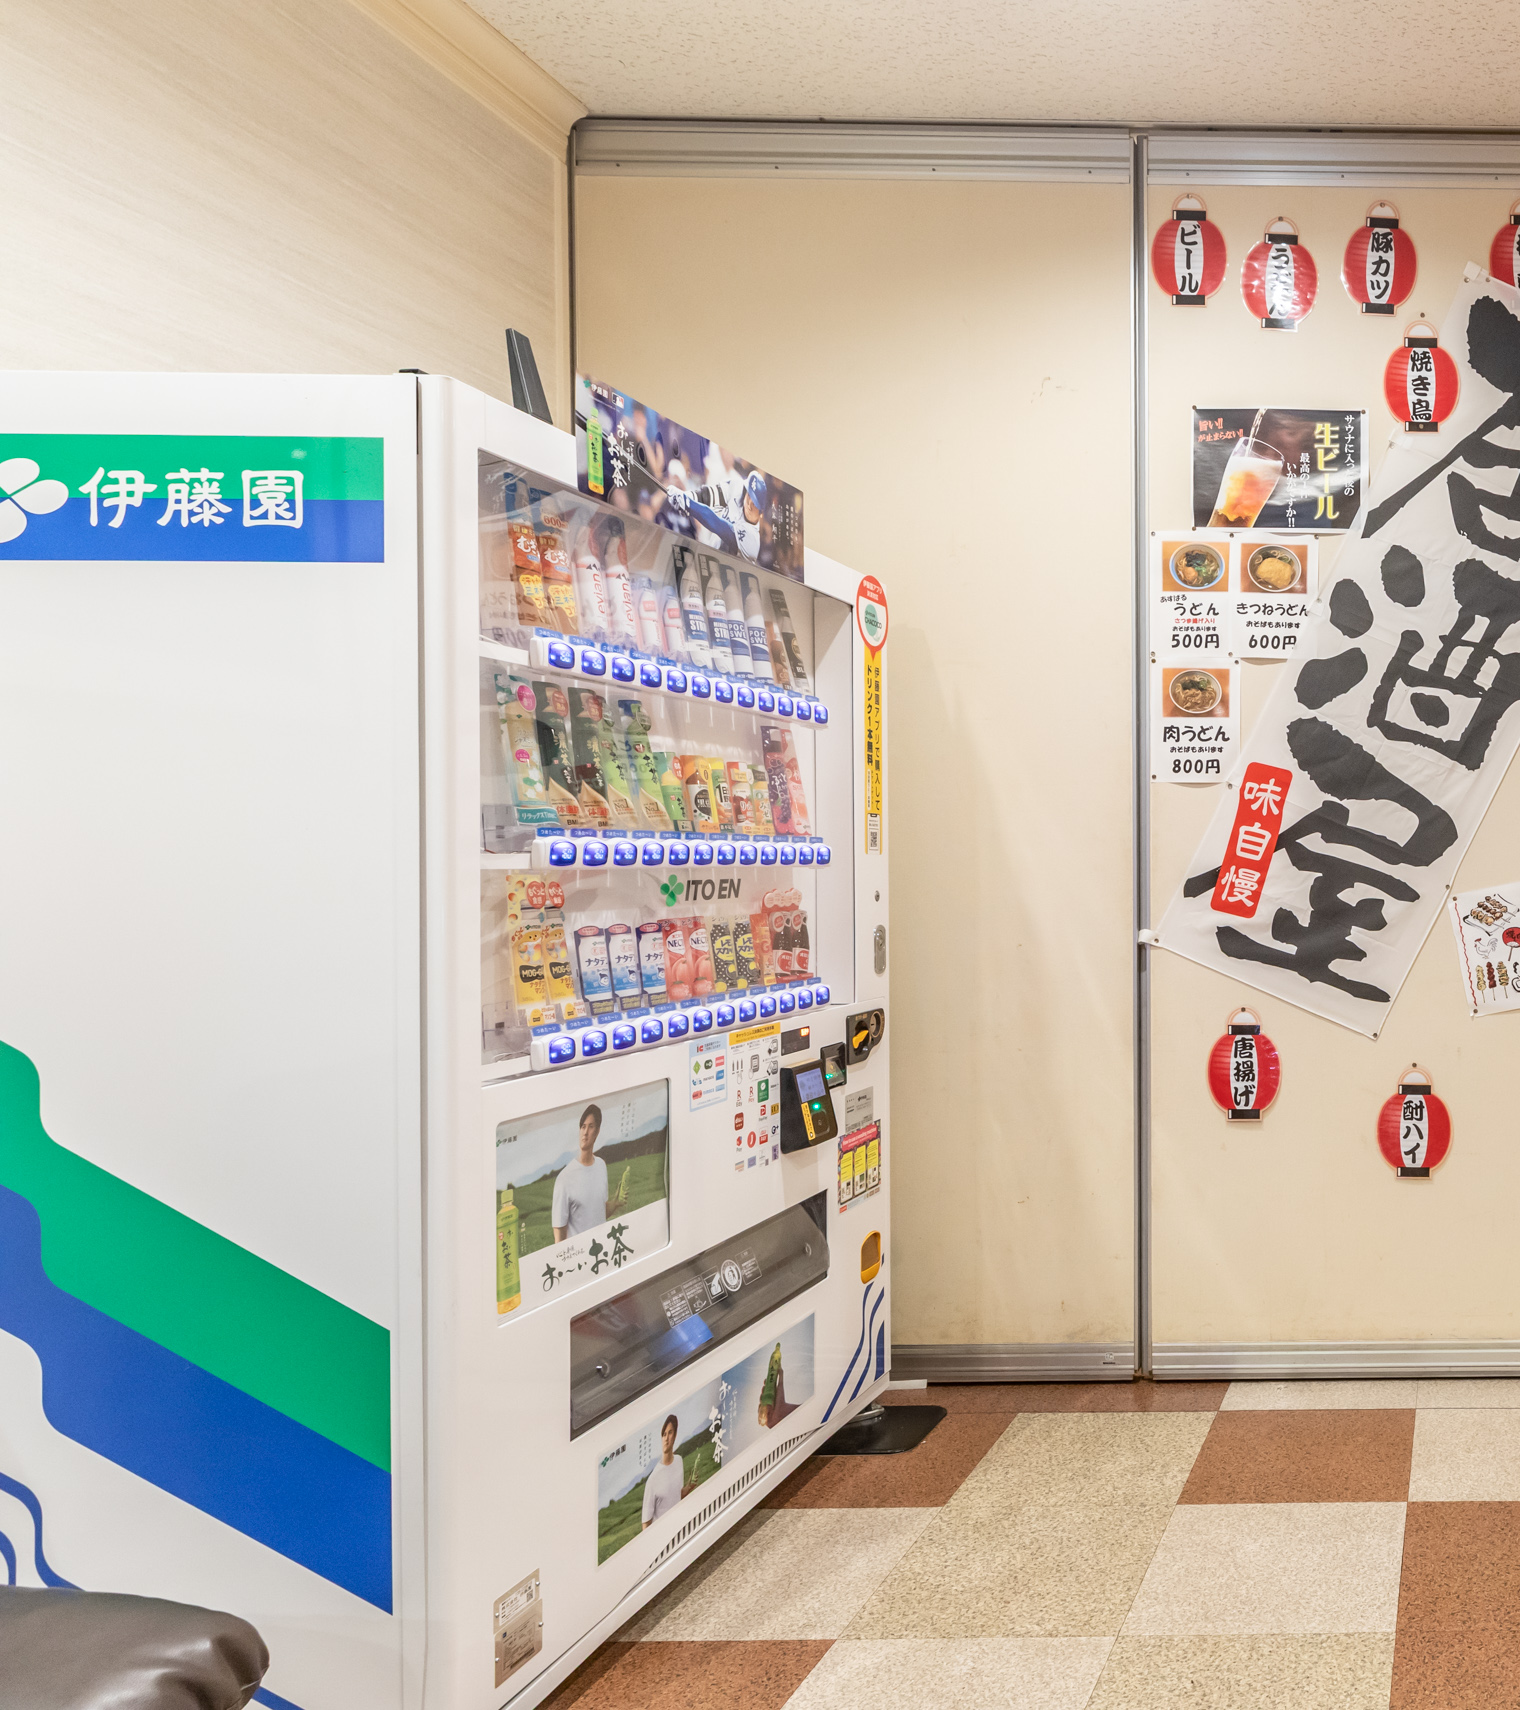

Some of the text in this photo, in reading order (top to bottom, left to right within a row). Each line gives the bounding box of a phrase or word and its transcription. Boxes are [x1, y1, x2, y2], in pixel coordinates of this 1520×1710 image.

[1177, 223, 1200, 294] ビール
[1370, 231, 1393, 300] 豚カツ
[1410, 350, 1433, 421] 焼き鳥
[1314, 423, 1340, 520] 生ビール
[78, 467, 304, 529] 伊藤園
[593, 573, 606, 614] evian
[622, 583, 634, 622] evian
[1174, 603, 1219, 617] うどん
[1236, 603, 1309, 617] きつねうどん
[1171, 634, 1220, 649] 500円
[1245, 621, 1301, 629] おそばもあります
[1248, 635, 1297, 650] 600円
[1162, 725, 1231, 743] 肉うどん
[1172, 759, 1221, 774] 800円
[1221, 778, 1282, 908] 味自慢
[685, 878, 741, 901] ITO EN
[1233, 1037, 1256, 1107] 唐揚げ
[1402, 1100, 1425, 1164] 酎ハイ
